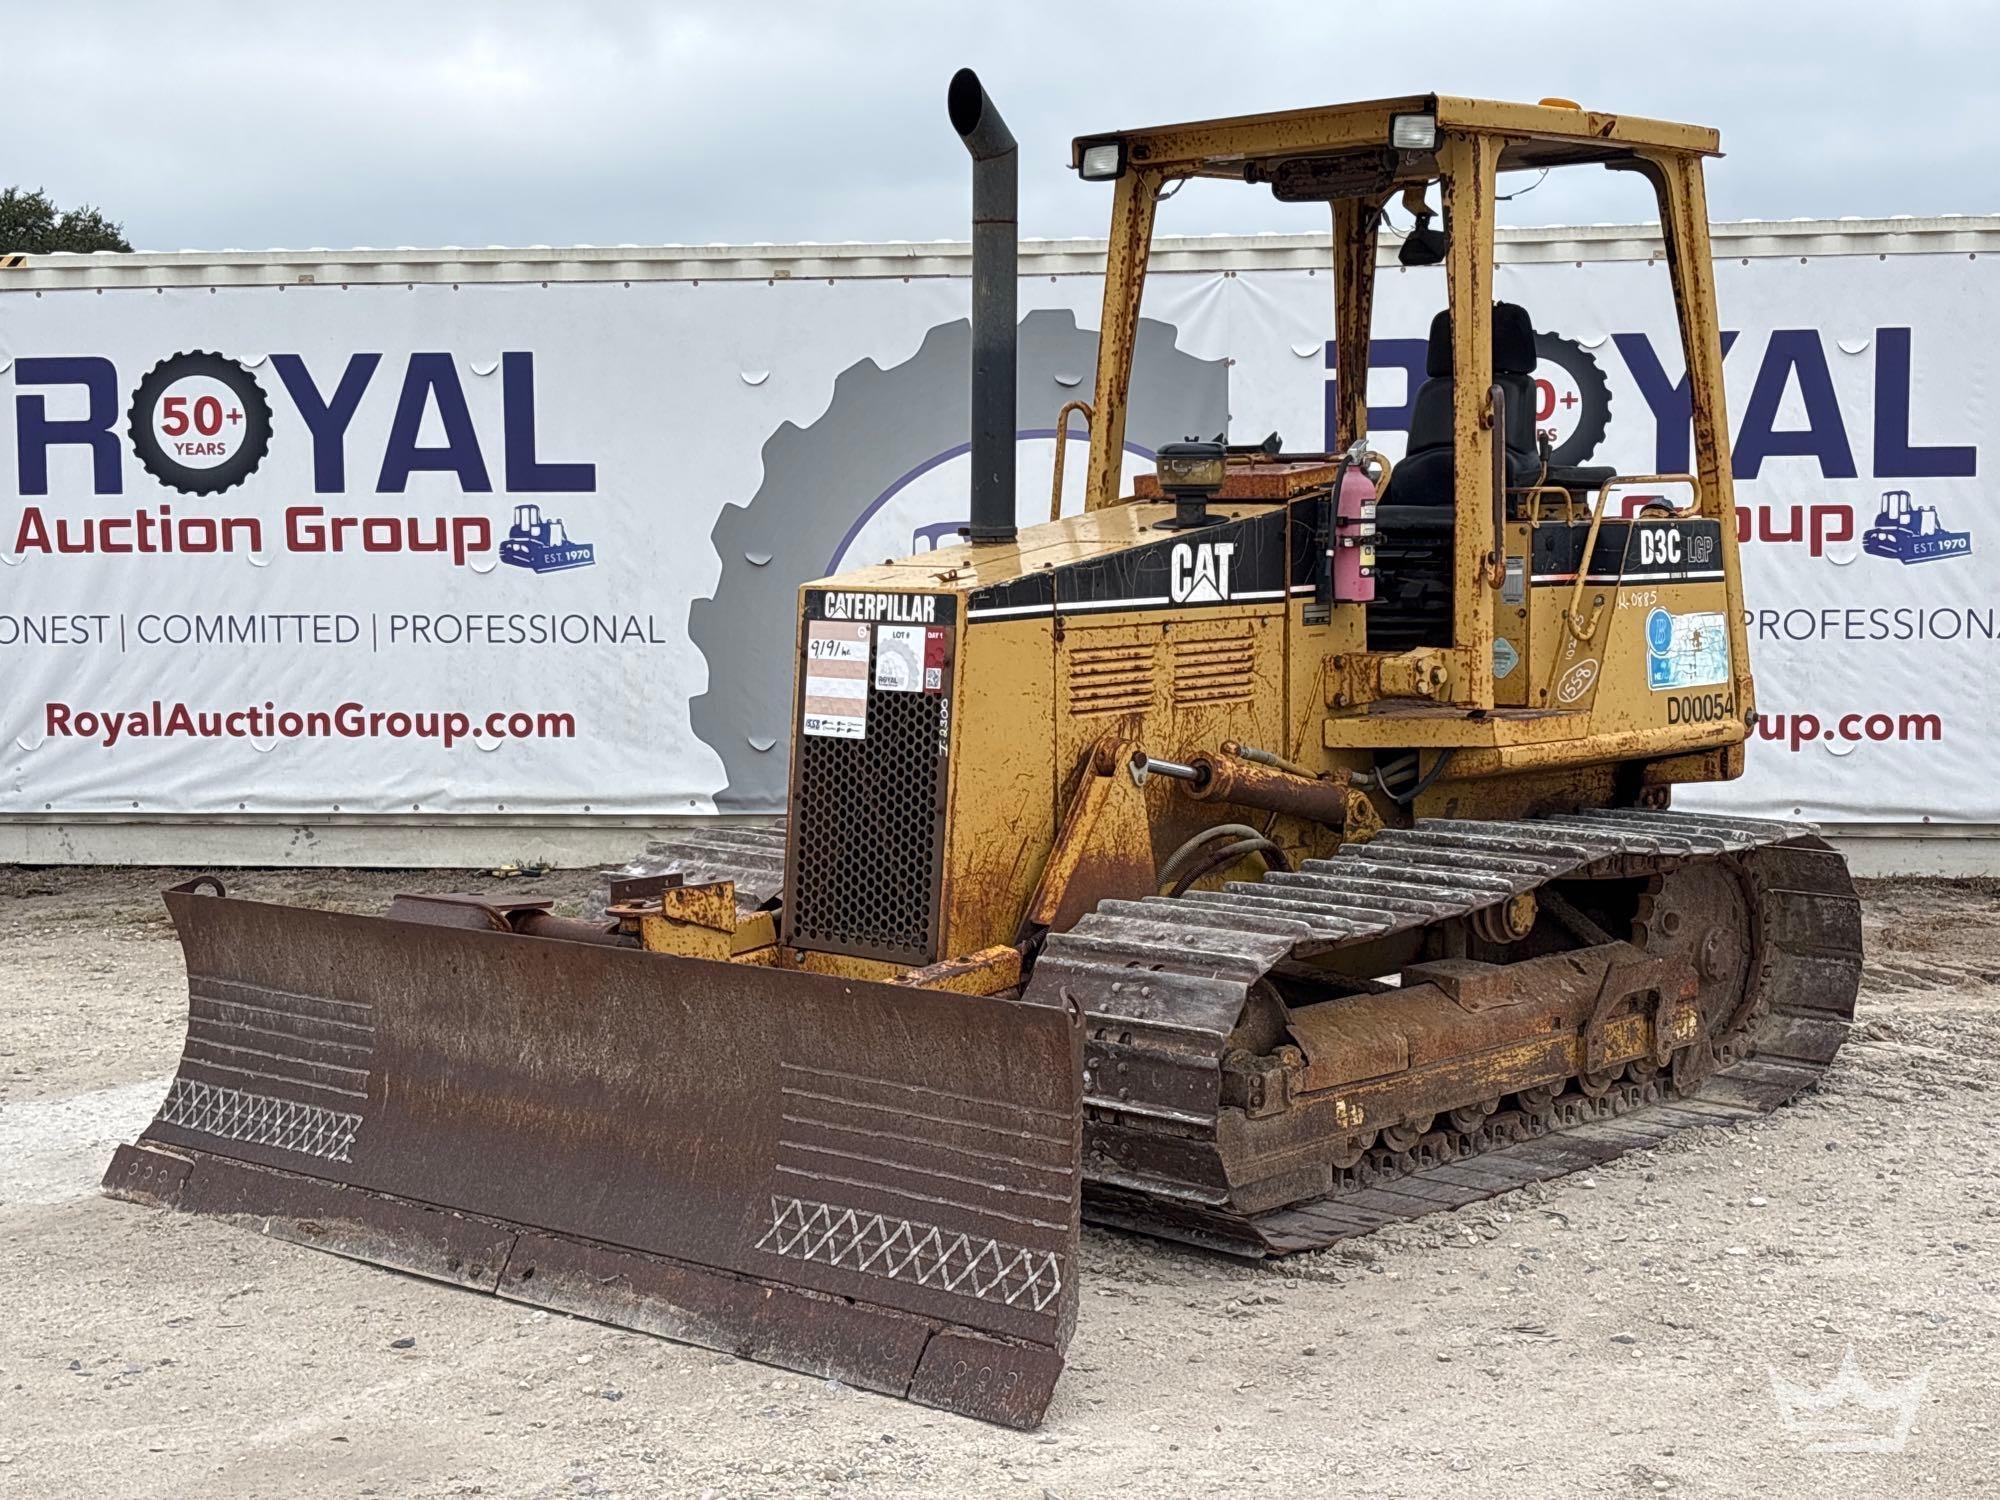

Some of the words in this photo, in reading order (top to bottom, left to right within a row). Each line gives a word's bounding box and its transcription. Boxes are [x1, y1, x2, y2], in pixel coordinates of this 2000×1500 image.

[14, 349, 596, 497] ROYAL
[161, 395, 243, 437] 50+
[174, 442, 226, 456] YEARS
[15, 504, 262, 554] Auction
[285, 505, 491, 566] Group
[1640, 528, 1681, 566] D3C
[1687, 535, 1713, 563] LGP
[1914, 541, 1936, 554] EST.
[1938, 537, 1967, 551] 1970
[544, 552, 564, 563] EST.
[565, 549, 590, 561] 1970
[1171, 542, 1234, 603] CAT
[824, 591, 936, 623] CATERPILLAR
[137, 614, 360, 645] COMMITTED
[390, 612, 666, 645] PROFESSIONAL
[892, 631, 905, 639] LOT
[1562, 668, 1592, 701] 1558
[46, 700, 576, 748] RoyalAuctionGroup.com
[1667, 692, 1734, 726] D00054
